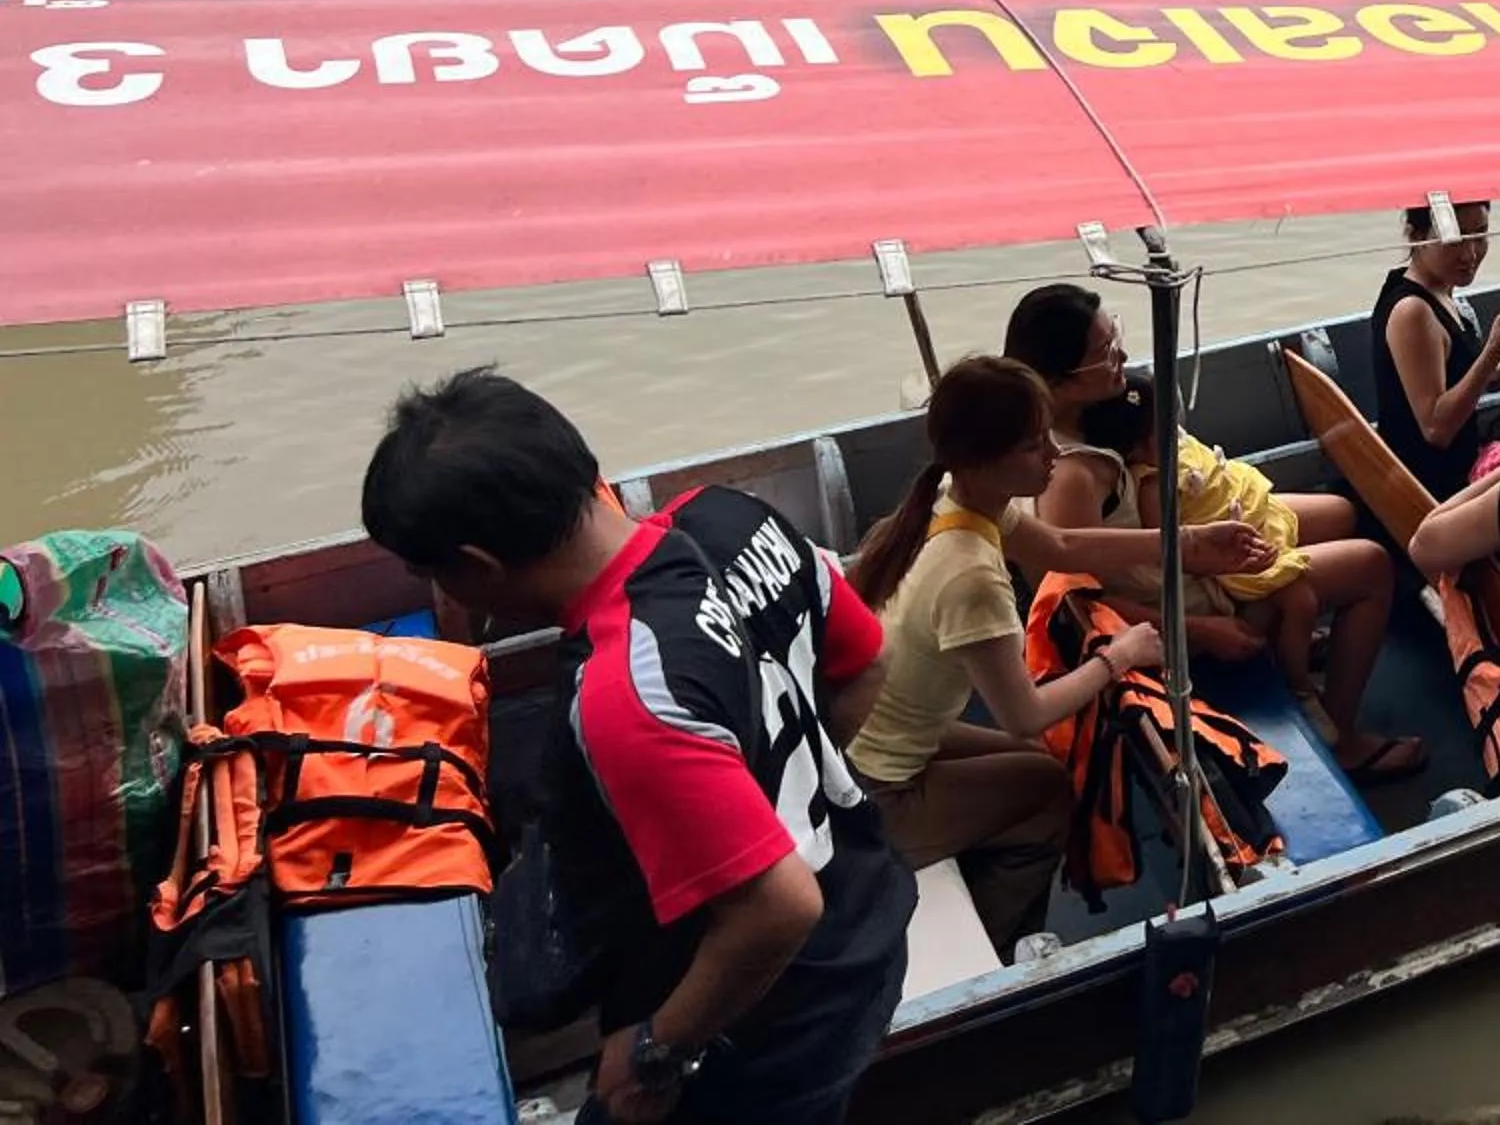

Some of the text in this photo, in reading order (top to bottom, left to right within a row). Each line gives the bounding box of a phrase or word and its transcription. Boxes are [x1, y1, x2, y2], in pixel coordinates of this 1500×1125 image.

[29, 41, 167, 107] 3
[243, 18, 840, 104] เม็ดยา
